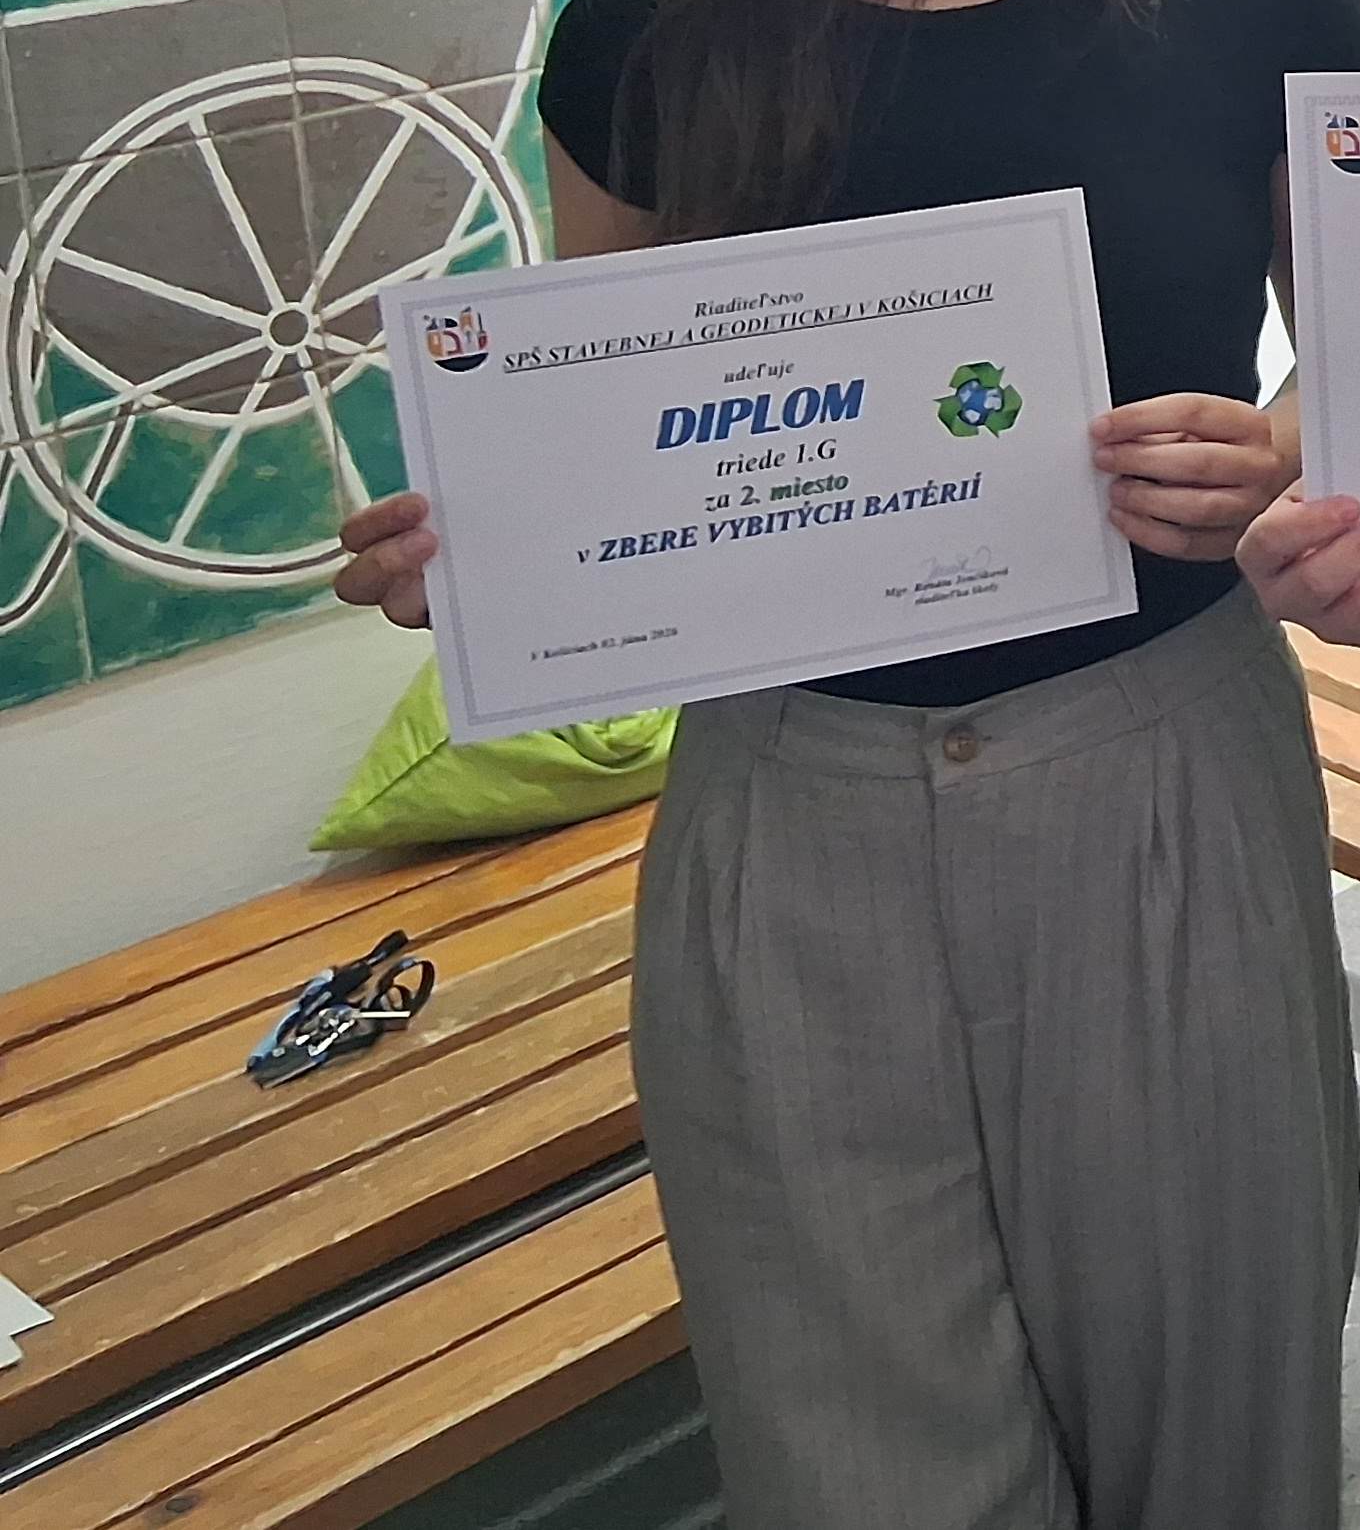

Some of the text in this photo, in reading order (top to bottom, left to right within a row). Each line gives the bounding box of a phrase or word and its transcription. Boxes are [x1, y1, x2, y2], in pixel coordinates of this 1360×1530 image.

[695, 293, 804, 319] Riaditeľstvo
[504, 283, 992, 368] SPŠ STAVEBNEJ A GEODETICKEJ V KOŠICIACH
[724, 360, 795, 384] udeľuje
[656, 379, 865, 450] DIPLOM
[717, 439, 837, 477] triede 1.G
[706, 475, 849, 512] za 2. miesto
[578, 472, 982, 564] v ZBERE VYBITÝCH BATÉRIÍ
